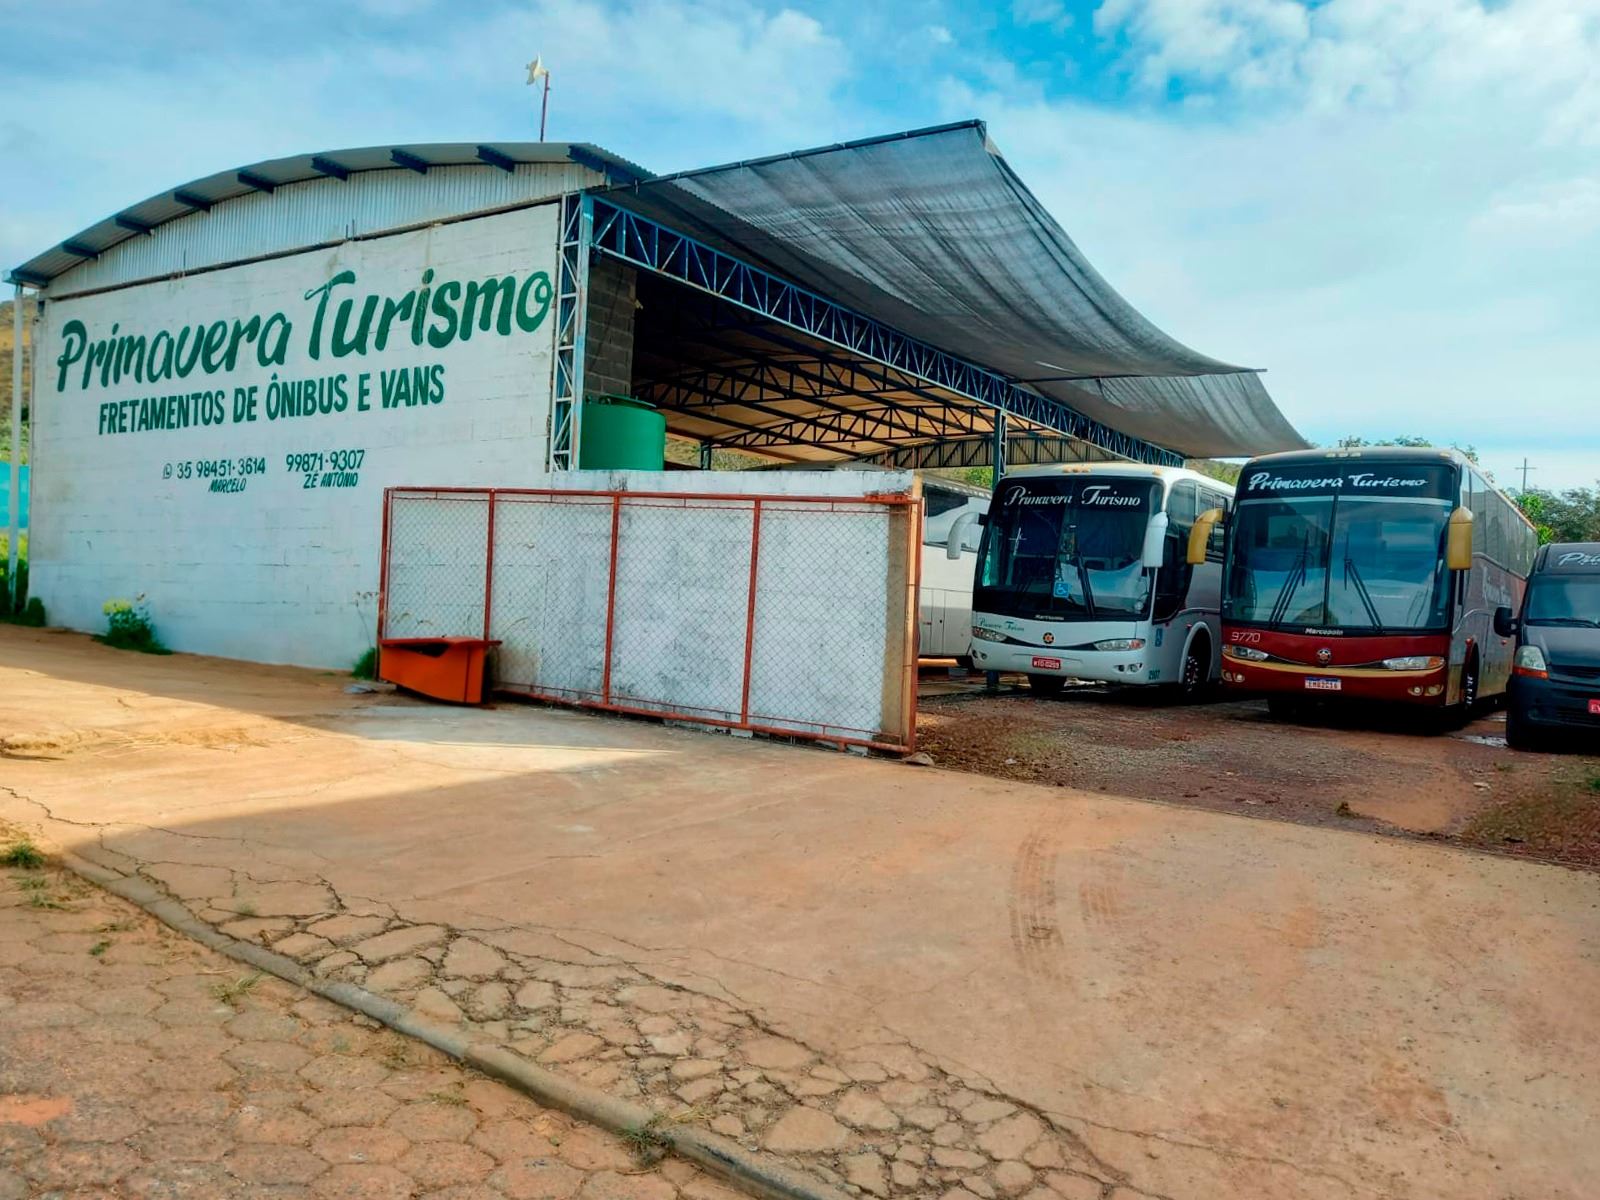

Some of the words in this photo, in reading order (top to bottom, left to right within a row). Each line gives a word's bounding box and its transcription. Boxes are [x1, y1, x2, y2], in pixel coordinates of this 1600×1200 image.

[57, 312, 293, 393] Primavera
[304, 268, 554, 361] Turismo
[99, 390, 226, 435] FRETAMENTOS
[233, 386, 258, 423] DE
[266, 372, 348, 421] ÔNIBUS
[357, 373, 371, 412] E
[380, 364, 445, 408] VANS
[176, 461, 192, 479] 35
[208, 478, 247, 493] MARCELO
[1247, 472, 1344, 491] Primavera
[1348, 473, 1428, 487] Turismo
[1004, 485, 1073, 506] Primavera
[1081, 485, 1141, 506] Turismo
[1231, 631, 1261, 643] 9770
